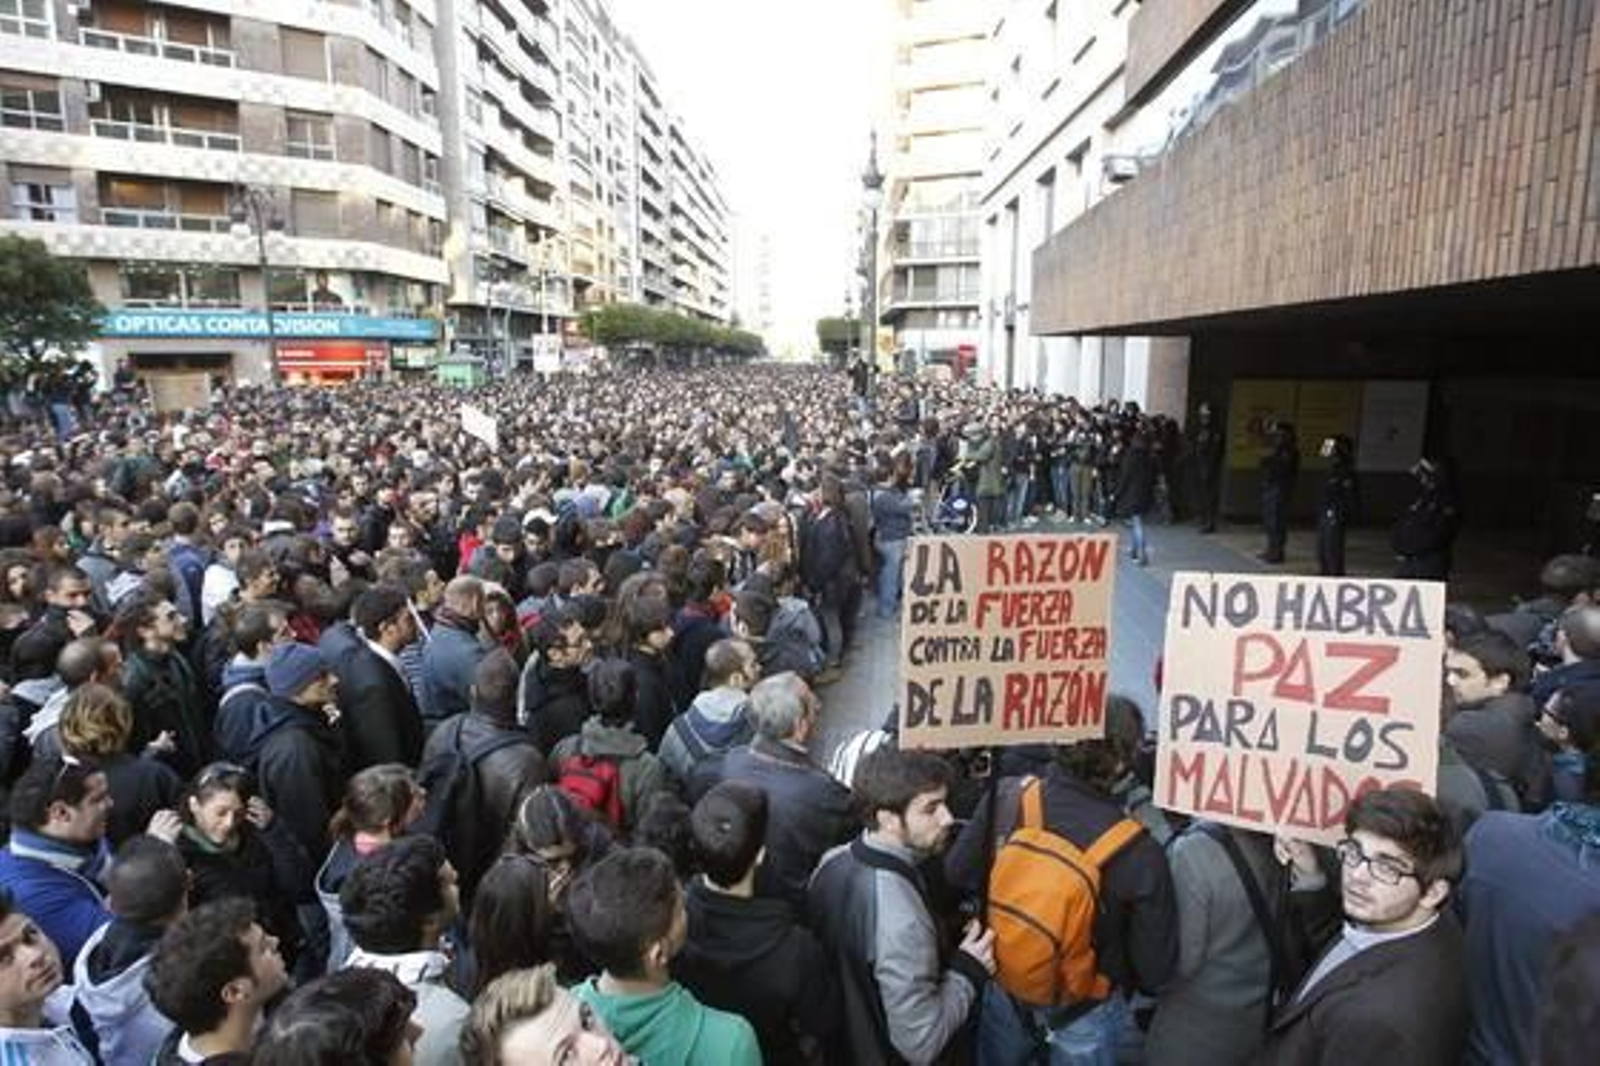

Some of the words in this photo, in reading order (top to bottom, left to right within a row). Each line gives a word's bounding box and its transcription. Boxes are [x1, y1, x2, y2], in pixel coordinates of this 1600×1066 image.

[115, 314, 201, 332] OPTICAS
[910, 541, 963, 597] LA
[986, 536, 1110, 587] RAZÓN
[910, 600, 940, 625] DE
[944, 598, 968, 625] LA
[974, 588, 1074, 630] FUERZA
[1181, 581, 1260, 629] NO
[1274, 581, 1432, 640] HABRA
[909, 636, 981, 667] CONTRA
[990, 636, 1016, 663] LA
[1018, 626, 1108, 663] FUERZA
[1232, 632, 1400, 716] PAZ
[905, 677, 944, 729] DE
[950, 674, 995, 726] LA
[1002, 664, 1108, 731] RAZÓN
[1169, 694, 1280, 751] PARA
[1305, 708, 1415, 770] LOS
[1168, 750, 1423, 831] MALVAD
